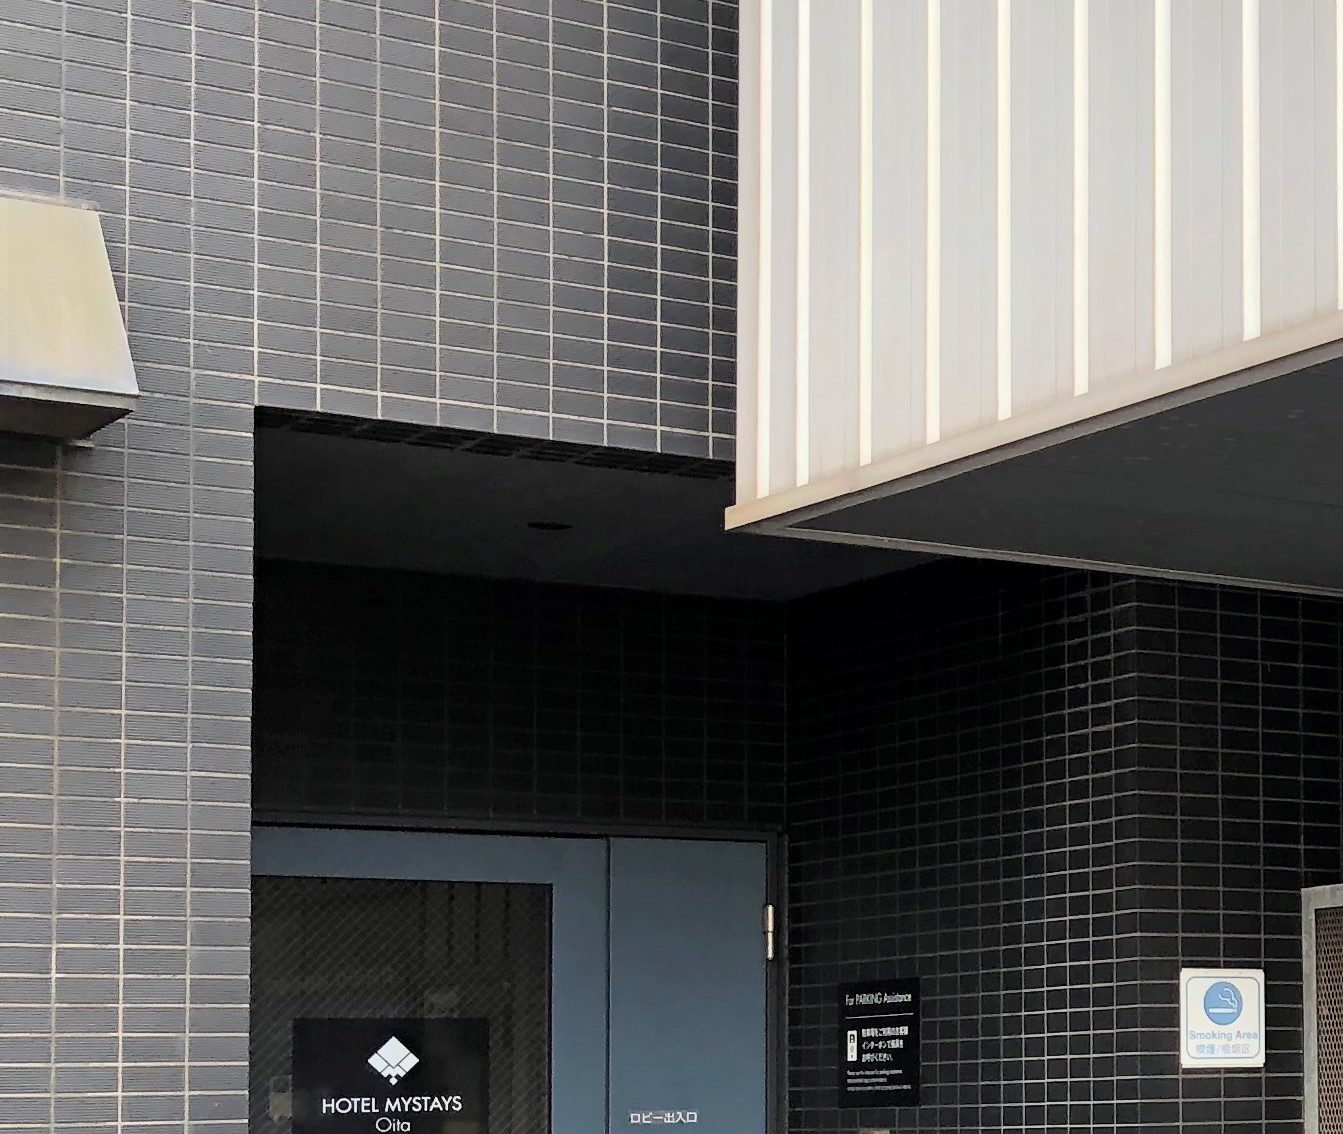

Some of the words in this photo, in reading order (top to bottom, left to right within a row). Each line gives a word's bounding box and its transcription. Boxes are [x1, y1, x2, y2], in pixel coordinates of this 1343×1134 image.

[1189, 1031, 1233, 1041] Smoking
[1235, 1030, 1258, 1039] Area
[322, 1097, 379, 1114] HOTEL
[384, 1095, 463, 1113] MYSTAYS
[375, 1117, 411, 1134] Oita
[629, 1110, 698, 1125] ロビー出入口
